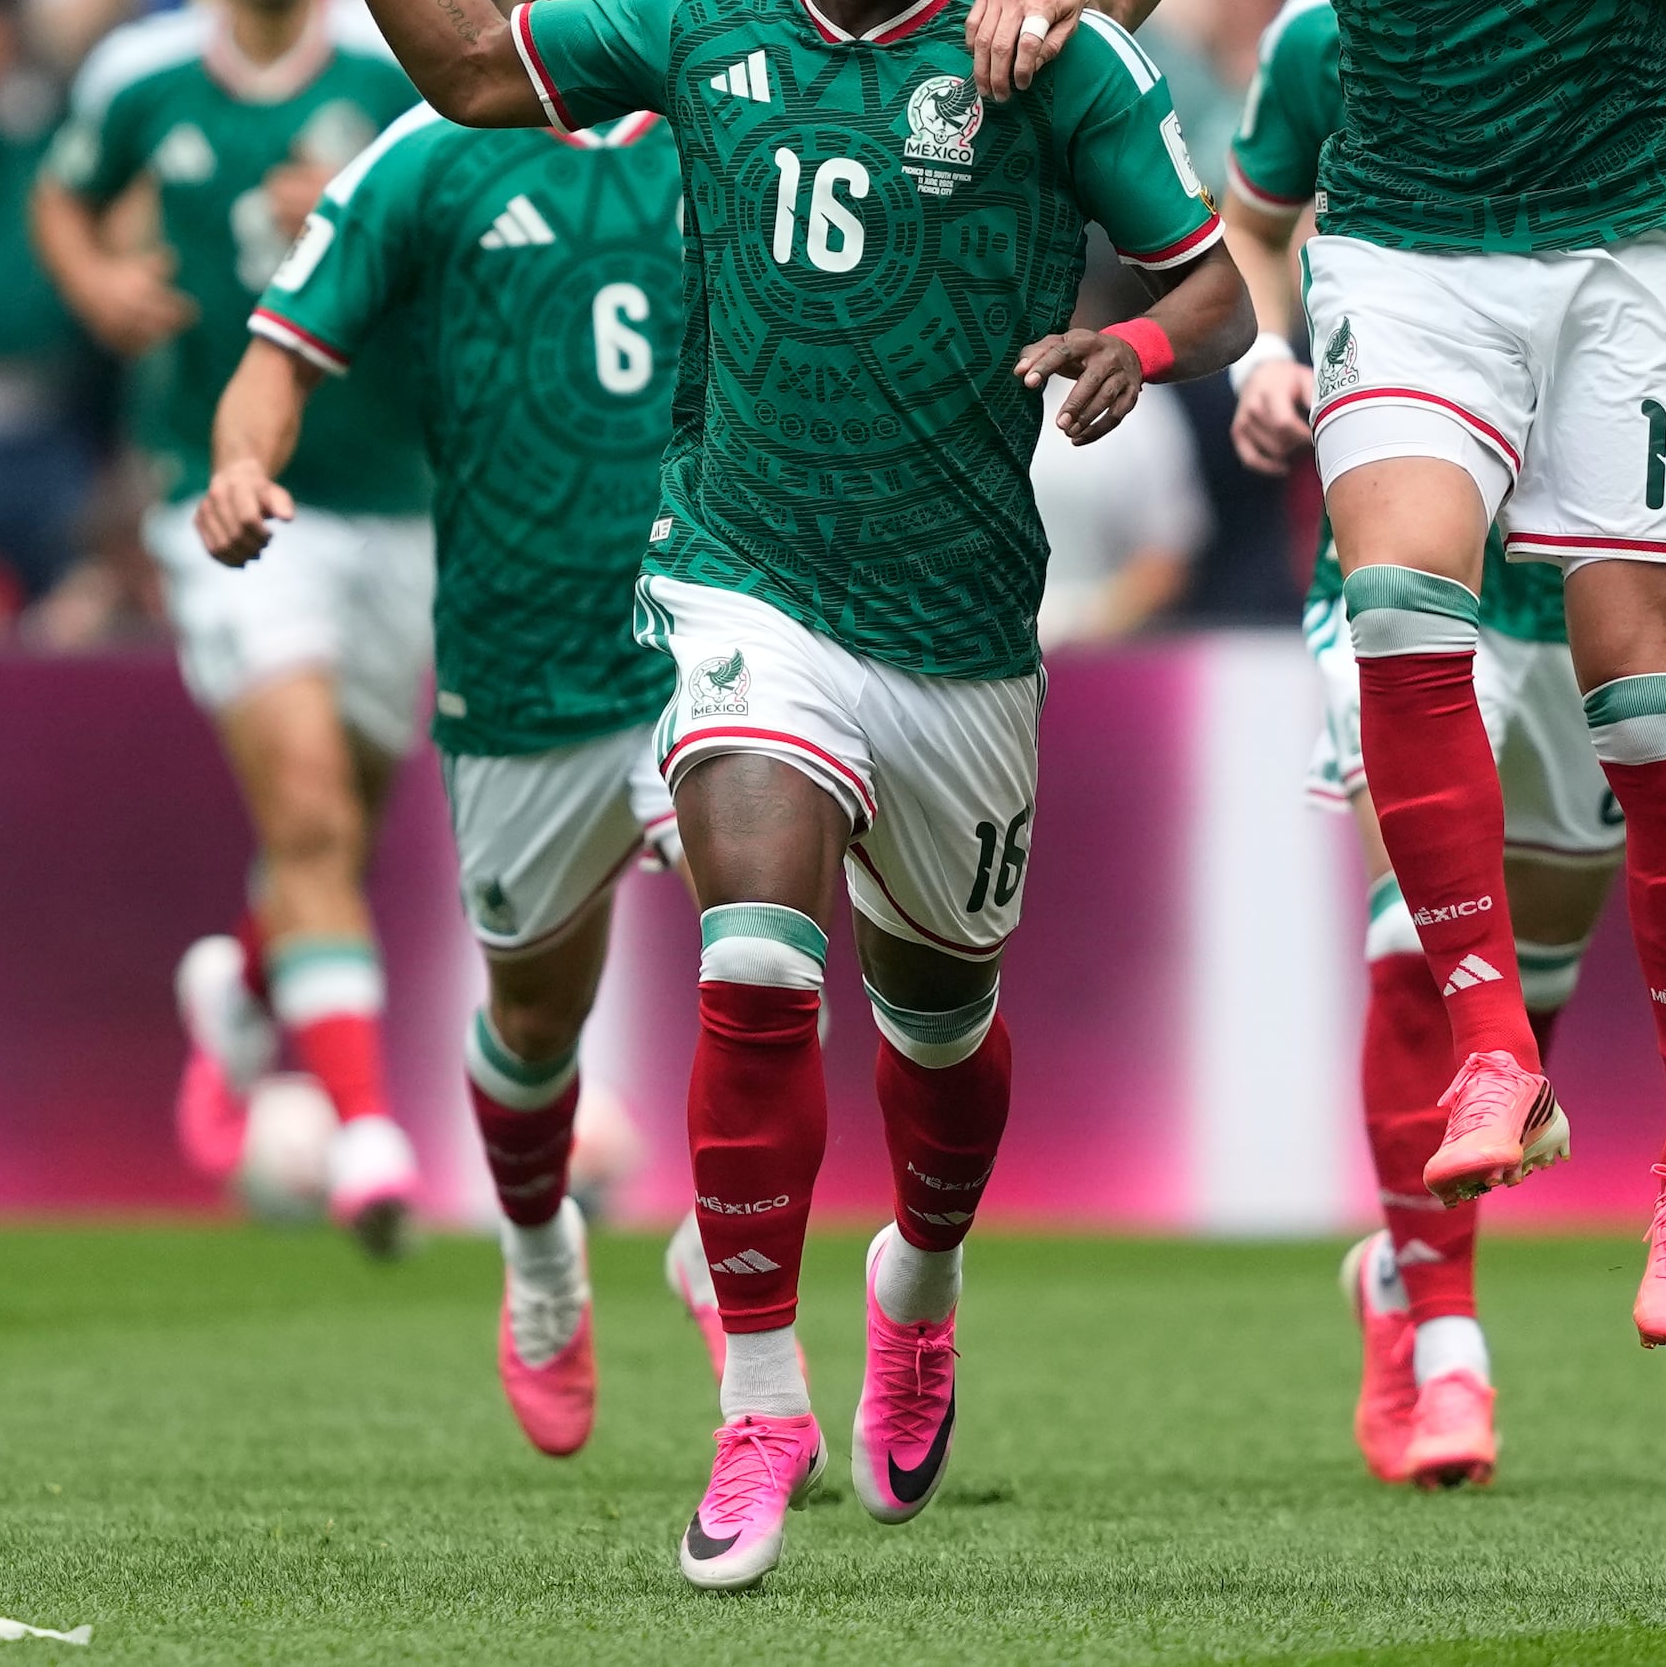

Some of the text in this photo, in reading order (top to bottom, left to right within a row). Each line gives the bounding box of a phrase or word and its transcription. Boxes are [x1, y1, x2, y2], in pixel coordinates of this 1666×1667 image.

[906, 141, 972, 162] MÉXICO
[771, 146, 870, 273] 16
[592, 282, 653, 395] 6
[966, 804, 1030, 913] 16
